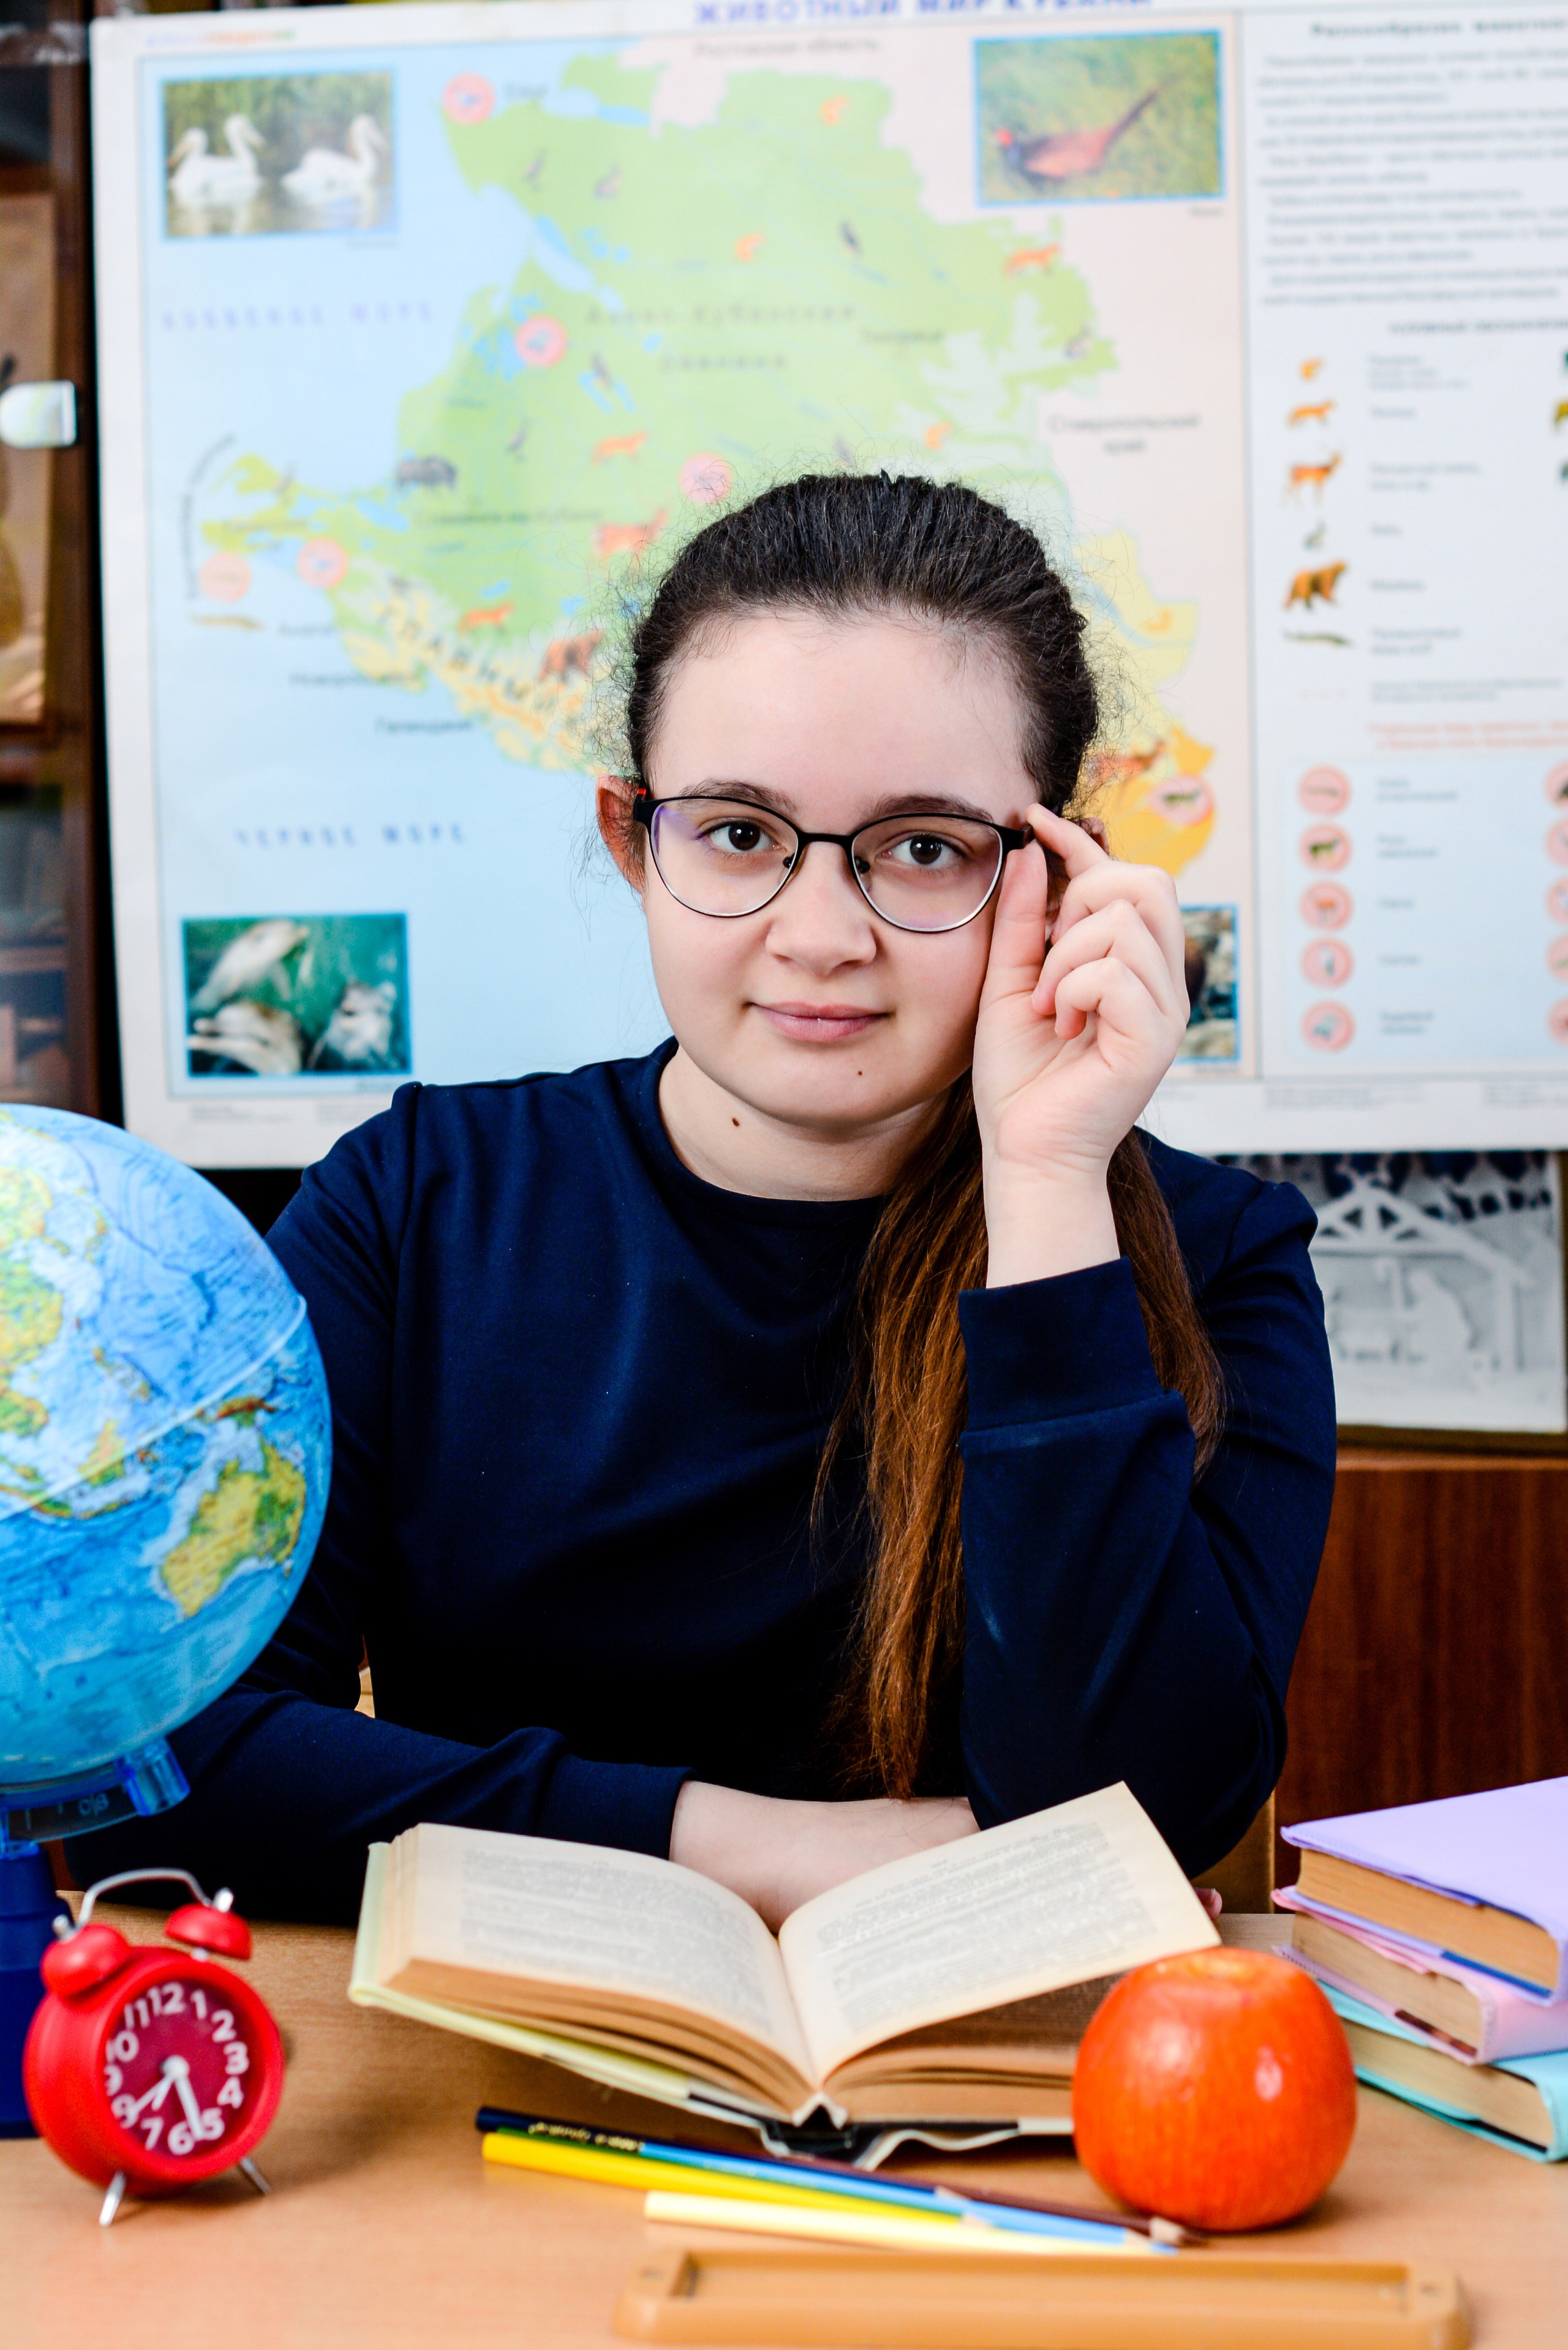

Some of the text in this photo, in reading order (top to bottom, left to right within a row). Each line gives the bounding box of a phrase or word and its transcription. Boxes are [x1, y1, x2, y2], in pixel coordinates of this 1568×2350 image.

[124, 1998, 151, 2030] 11
[146, 1982, 186, 2016] 12
[190, 1989, 207, 2020] 1
[210, 2009, 237, 2043] 2
[105, 2030, 140, 2063] 10
[222, 2040, 250, 2076] 3
[216, 2074, 244, 2109] 4
[110, 2093, 140, 2129] 8
[198, 2106, 225, 2141] 5
[140, 2115, 164, 2151] 7
[167, 2119, 195, 2155] 6
